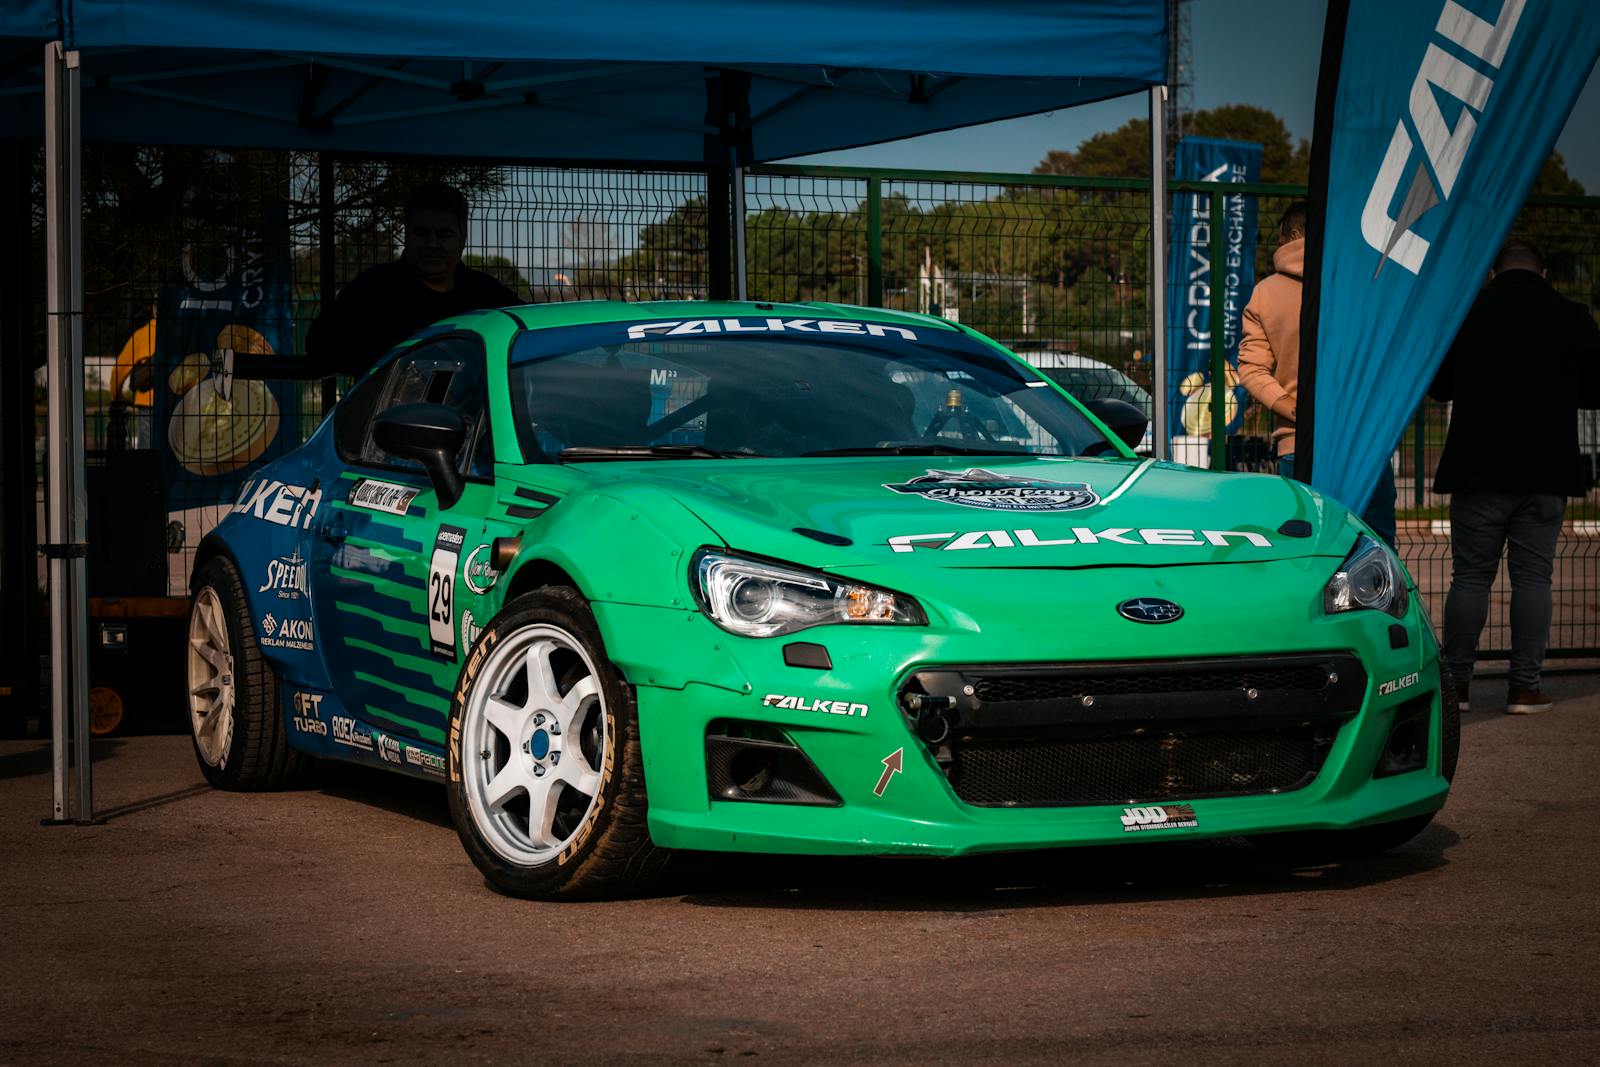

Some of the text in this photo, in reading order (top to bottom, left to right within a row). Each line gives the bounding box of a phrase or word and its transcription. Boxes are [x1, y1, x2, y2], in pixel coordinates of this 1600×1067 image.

[1224, 273, 1241, 349] CRYPTO
[628, 319, 917, 341] FALKEN
[886, 527, 1273, 553] FALKEN
[431, 571, 451, 625] 29
[1379, 672, 1419, 696] FALKEN
[450, 629, 497, 783] FALKEN
[763, 694, 869, 717] FALKEN
[293, 716, 328, 736] TURBO
